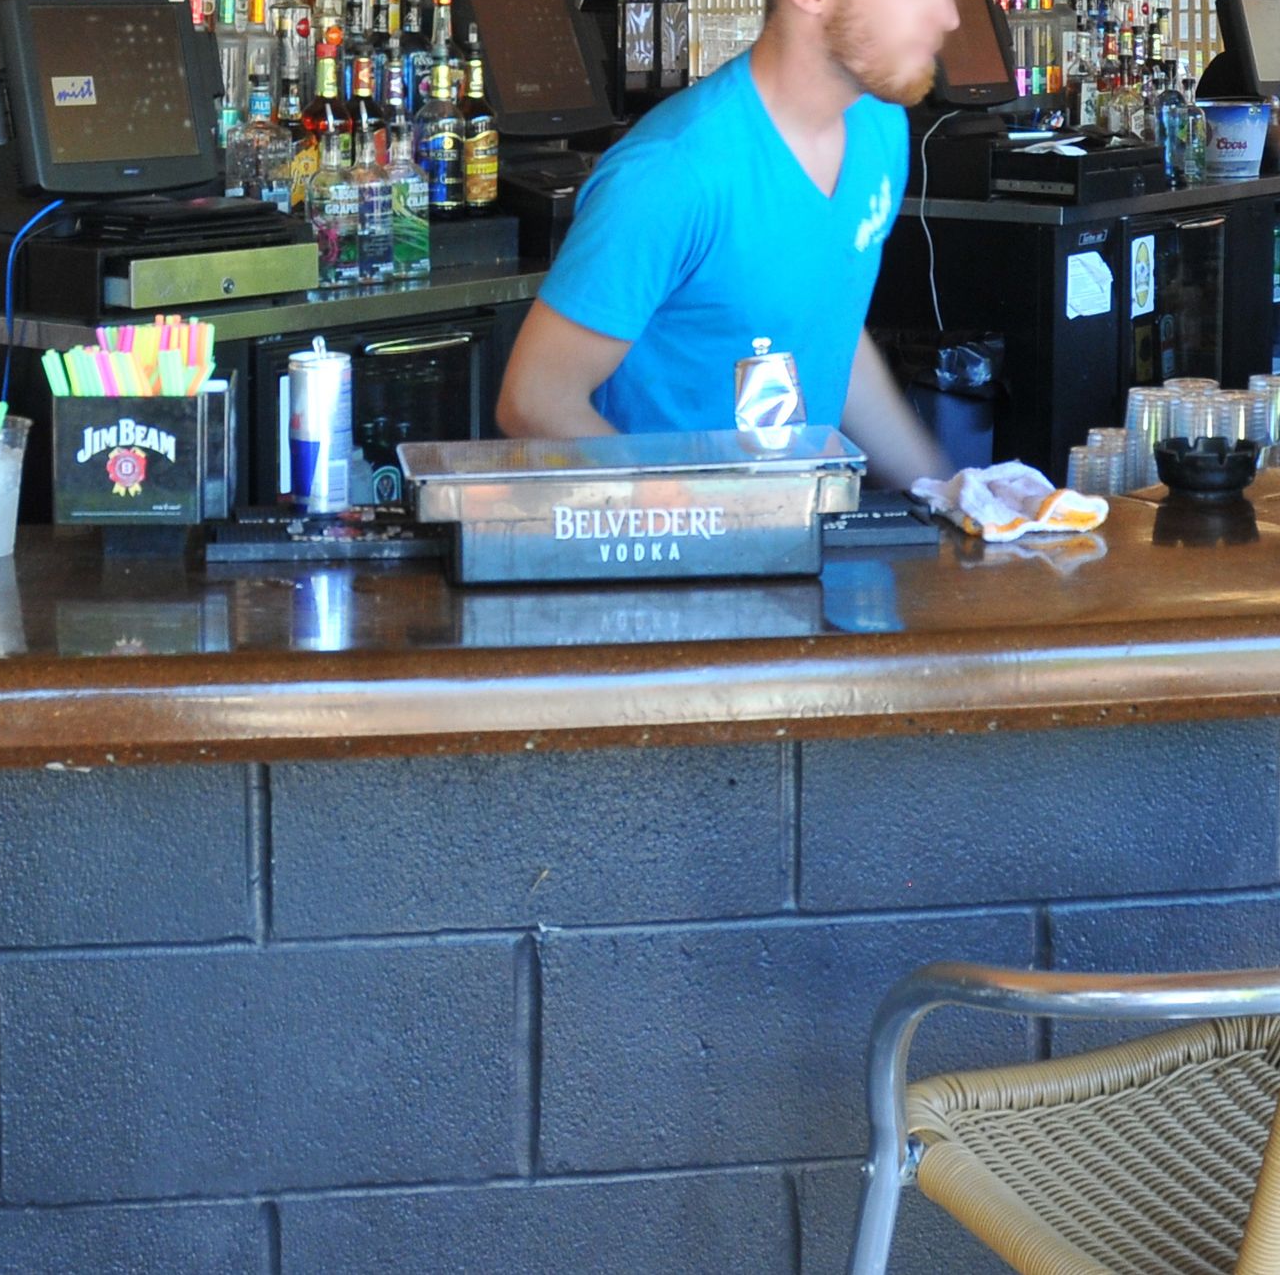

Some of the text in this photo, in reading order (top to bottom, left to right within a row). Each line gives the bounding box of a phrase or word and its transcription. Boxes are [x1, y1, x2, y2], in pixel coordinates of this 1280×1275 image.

[1216, 136, 1248, 151] Coors
[76, 418, 176, 463] JIM BEAM
[552, 506, 727, 540] BELVEDERE
[600, 542, 680, 563] VODKA
